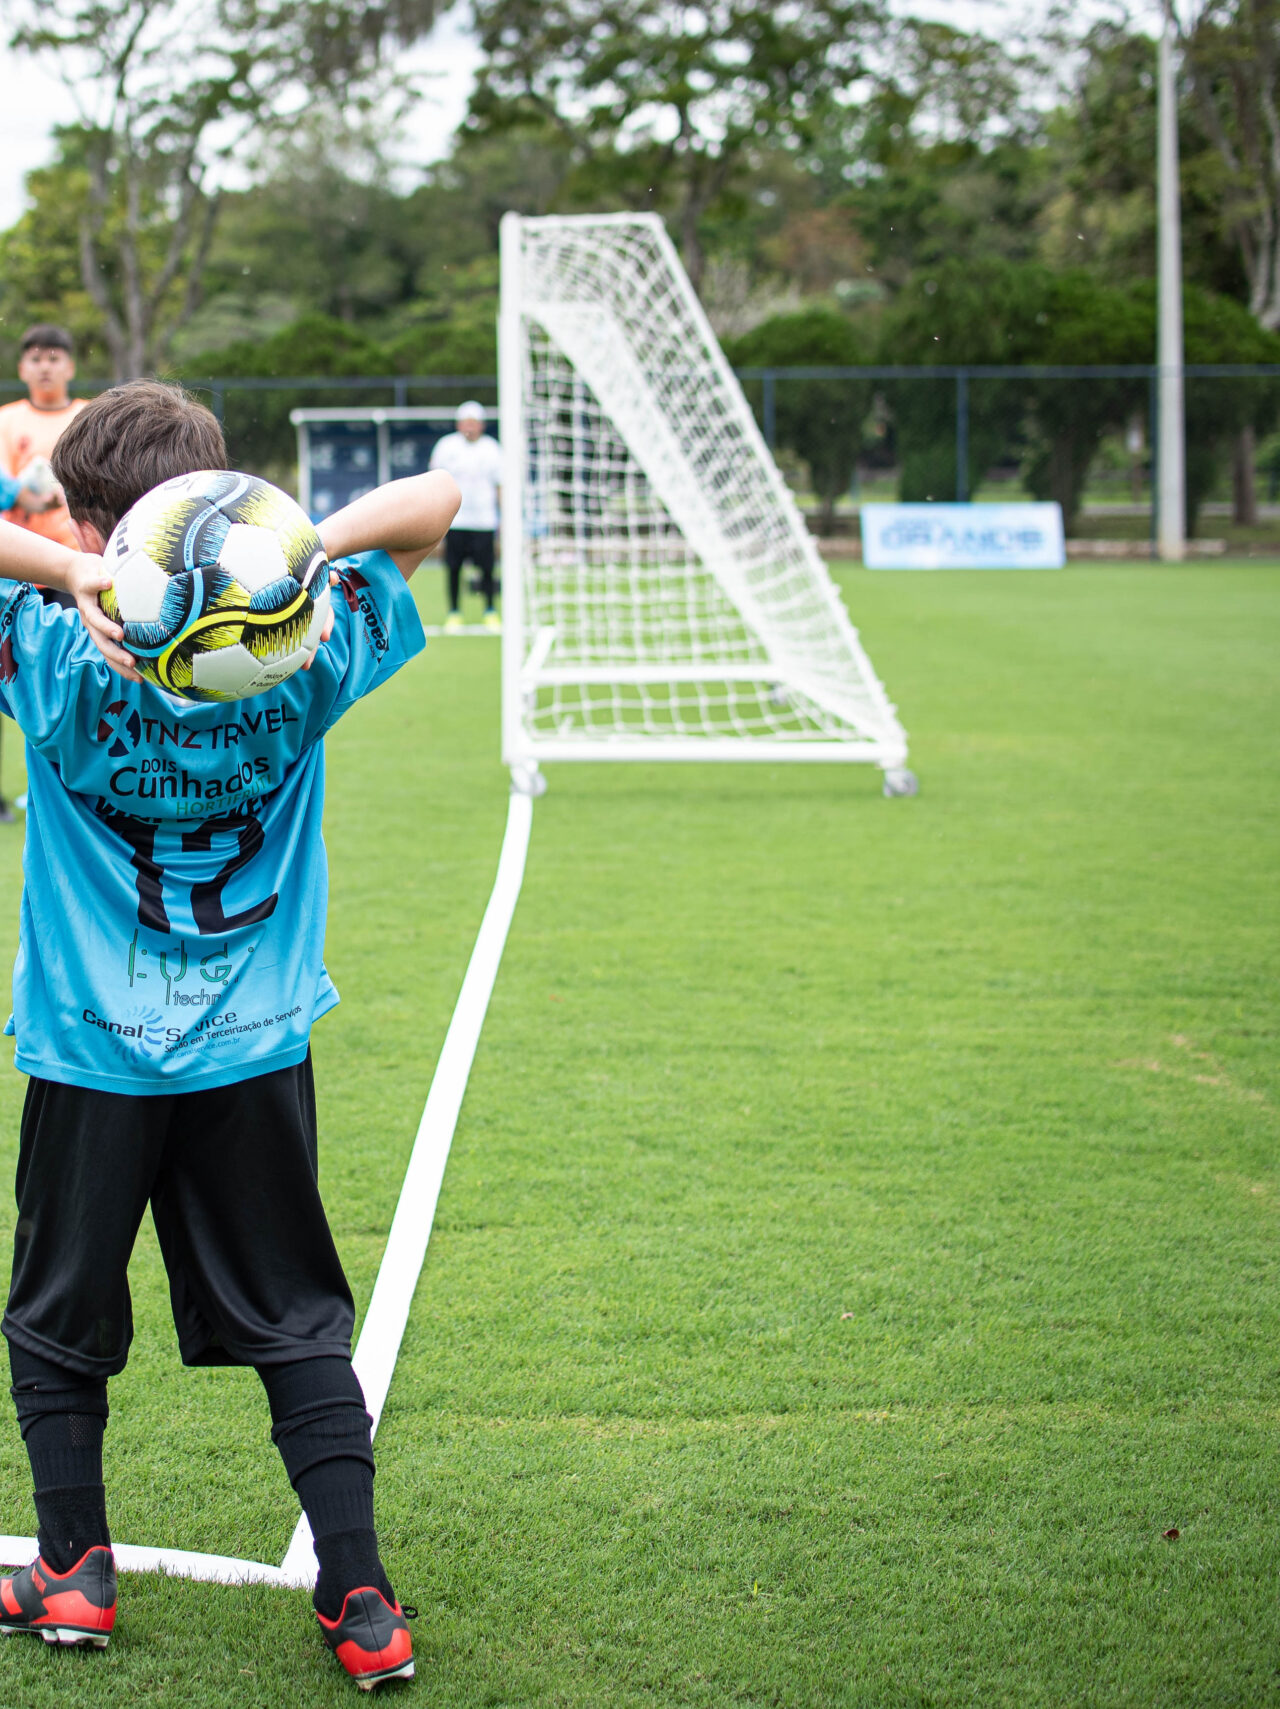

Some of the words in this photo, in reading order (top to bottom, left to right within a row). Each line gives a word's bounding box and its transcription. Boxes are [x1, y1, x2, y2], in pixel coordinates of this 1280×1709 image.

[109, 756, 269, 799] Cunhados
[141, 758, 177, 773] DOIS
[105, 816, 279, 935] 12
[82, 1008, 143, 1039] Canal
[165, 1011, 238, 1042] Svice
[190, 1034, 204, 1045] em
[206, 1020, 262, 1041] Terceirização
[263, 1017, 274, 1027] de
